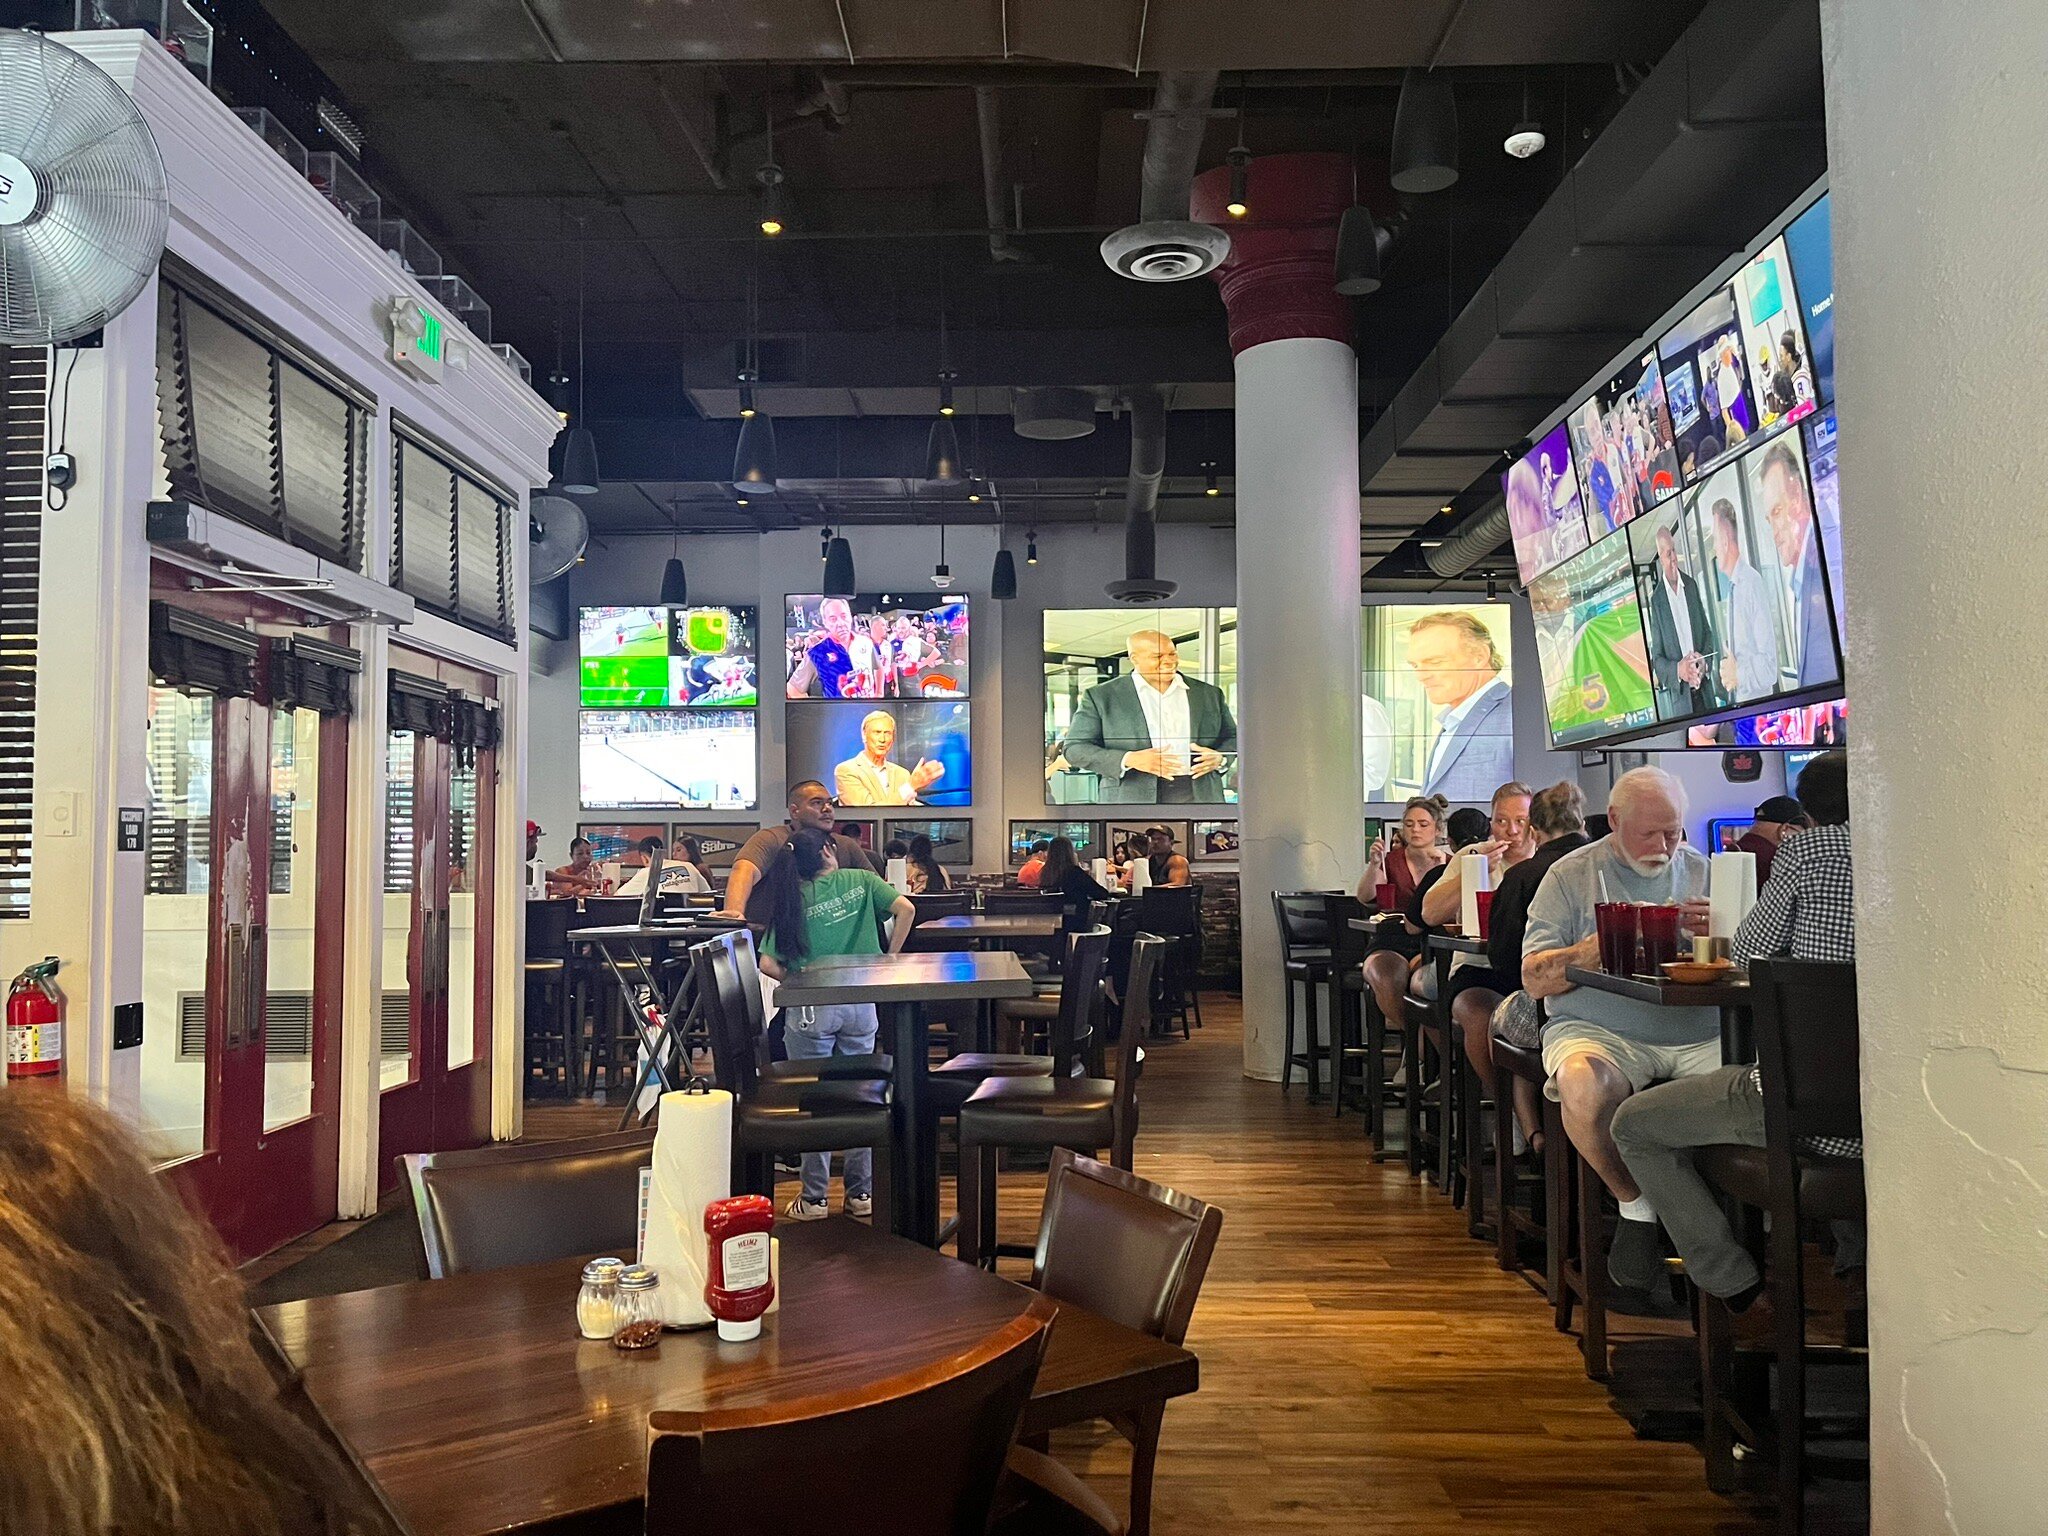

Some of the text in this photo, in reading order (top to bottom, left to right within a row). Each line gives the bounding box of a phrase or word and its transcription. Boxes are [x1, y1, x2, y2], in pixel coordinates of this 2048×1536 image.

[125, 824, 138, 836] LOAD
[661, 877, 691, 890] patagonia
[737, 1238, 758, 1248] HEINZ
